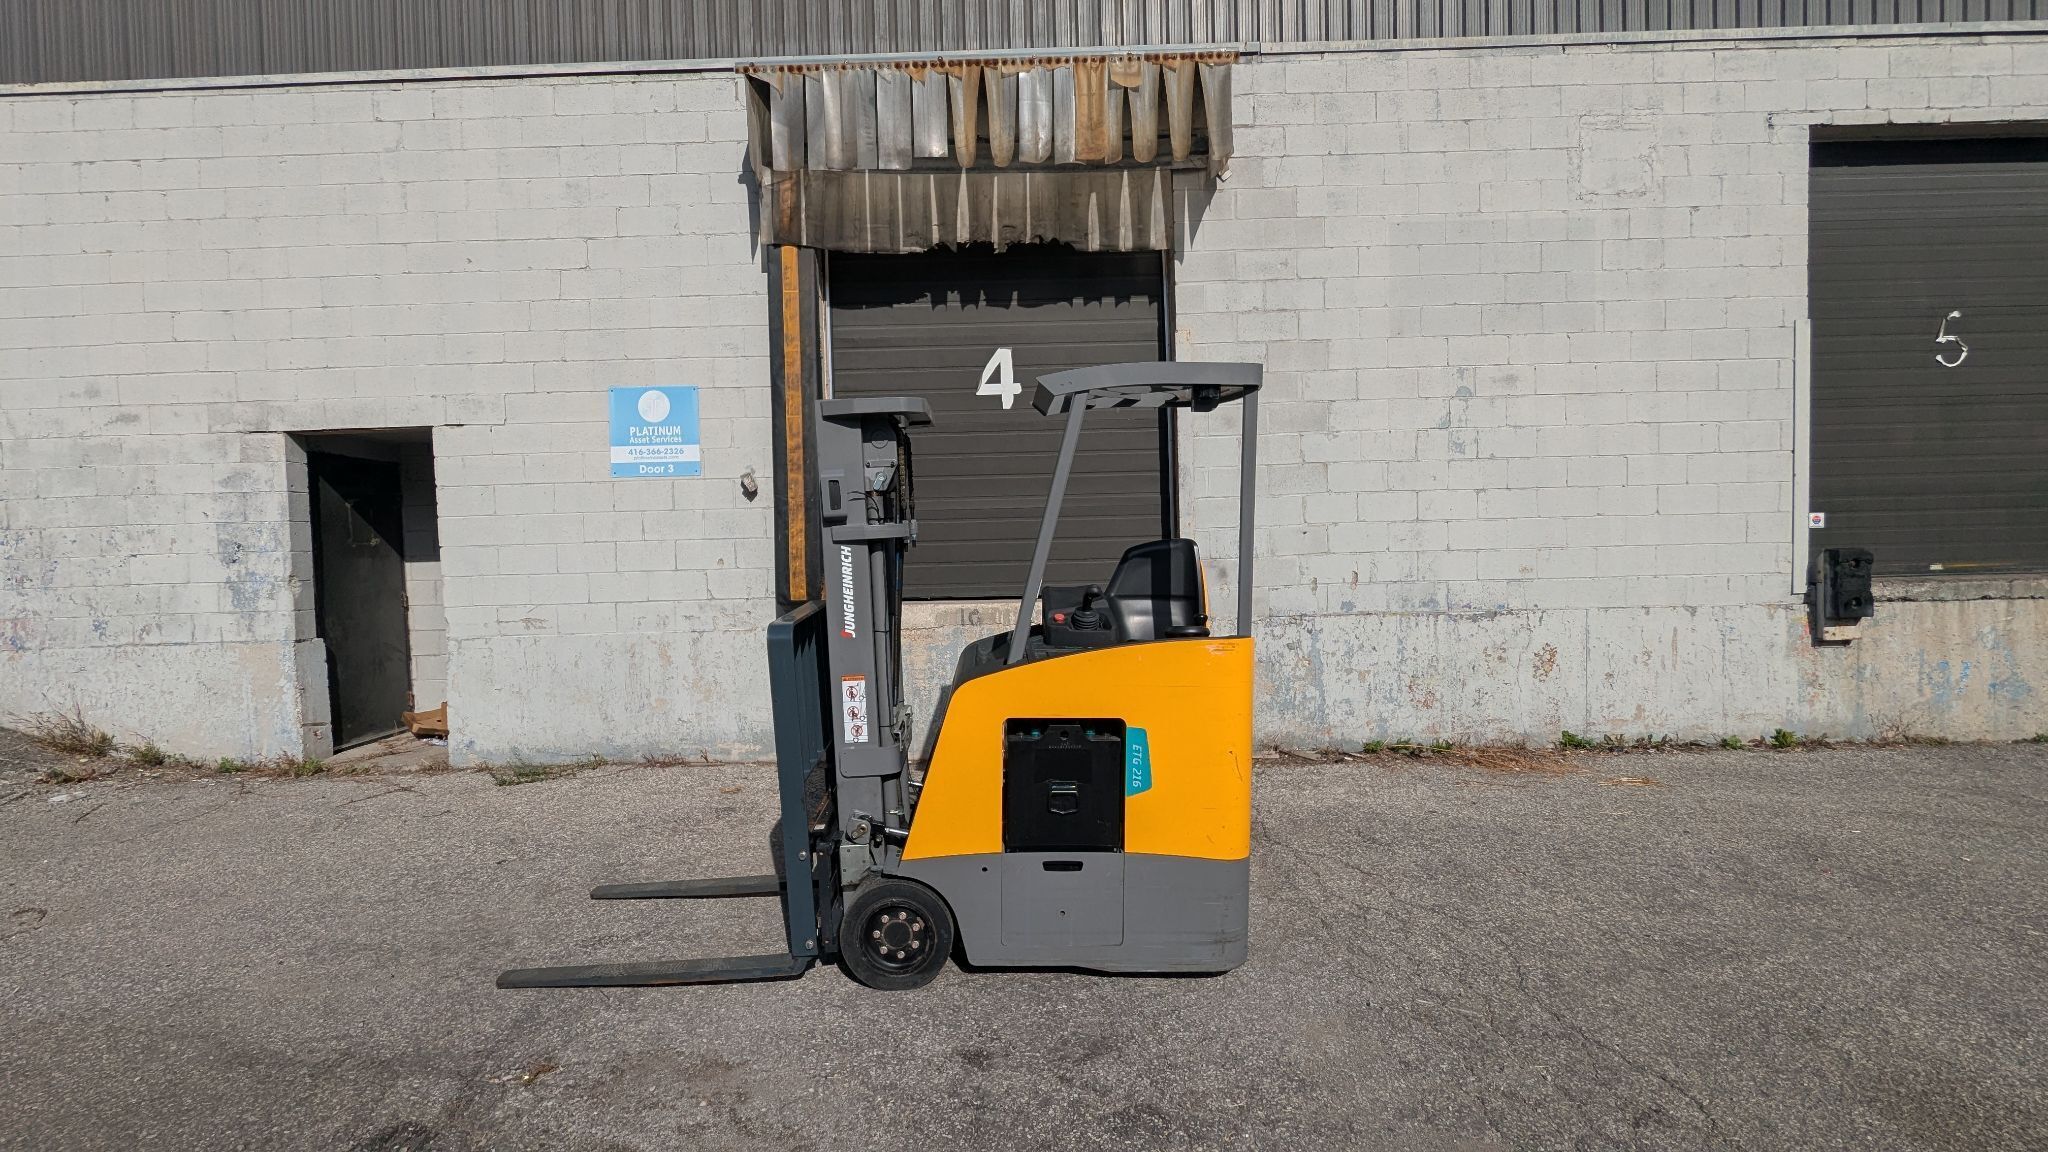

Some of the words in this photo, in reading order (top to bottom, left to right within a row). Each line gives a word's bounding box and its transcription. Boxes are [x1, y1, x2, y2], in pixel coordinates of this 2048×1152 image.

[1935, 310, 1969, 368] 5
[975, 346, 1022, 410] 4
[629, 426, 681, 436] PLATINUM
[629, 436, 650, 444] Asset
[651, 436, 682, 444] Services
[639, 464, 665, 475] Door
[668, 464, 675, 473] 3
[840, 545, 856, 639] JUNGHEINRICH
[1132, 743, 1142, 765] ETG
[1132, 767, 1142, 788] 216
